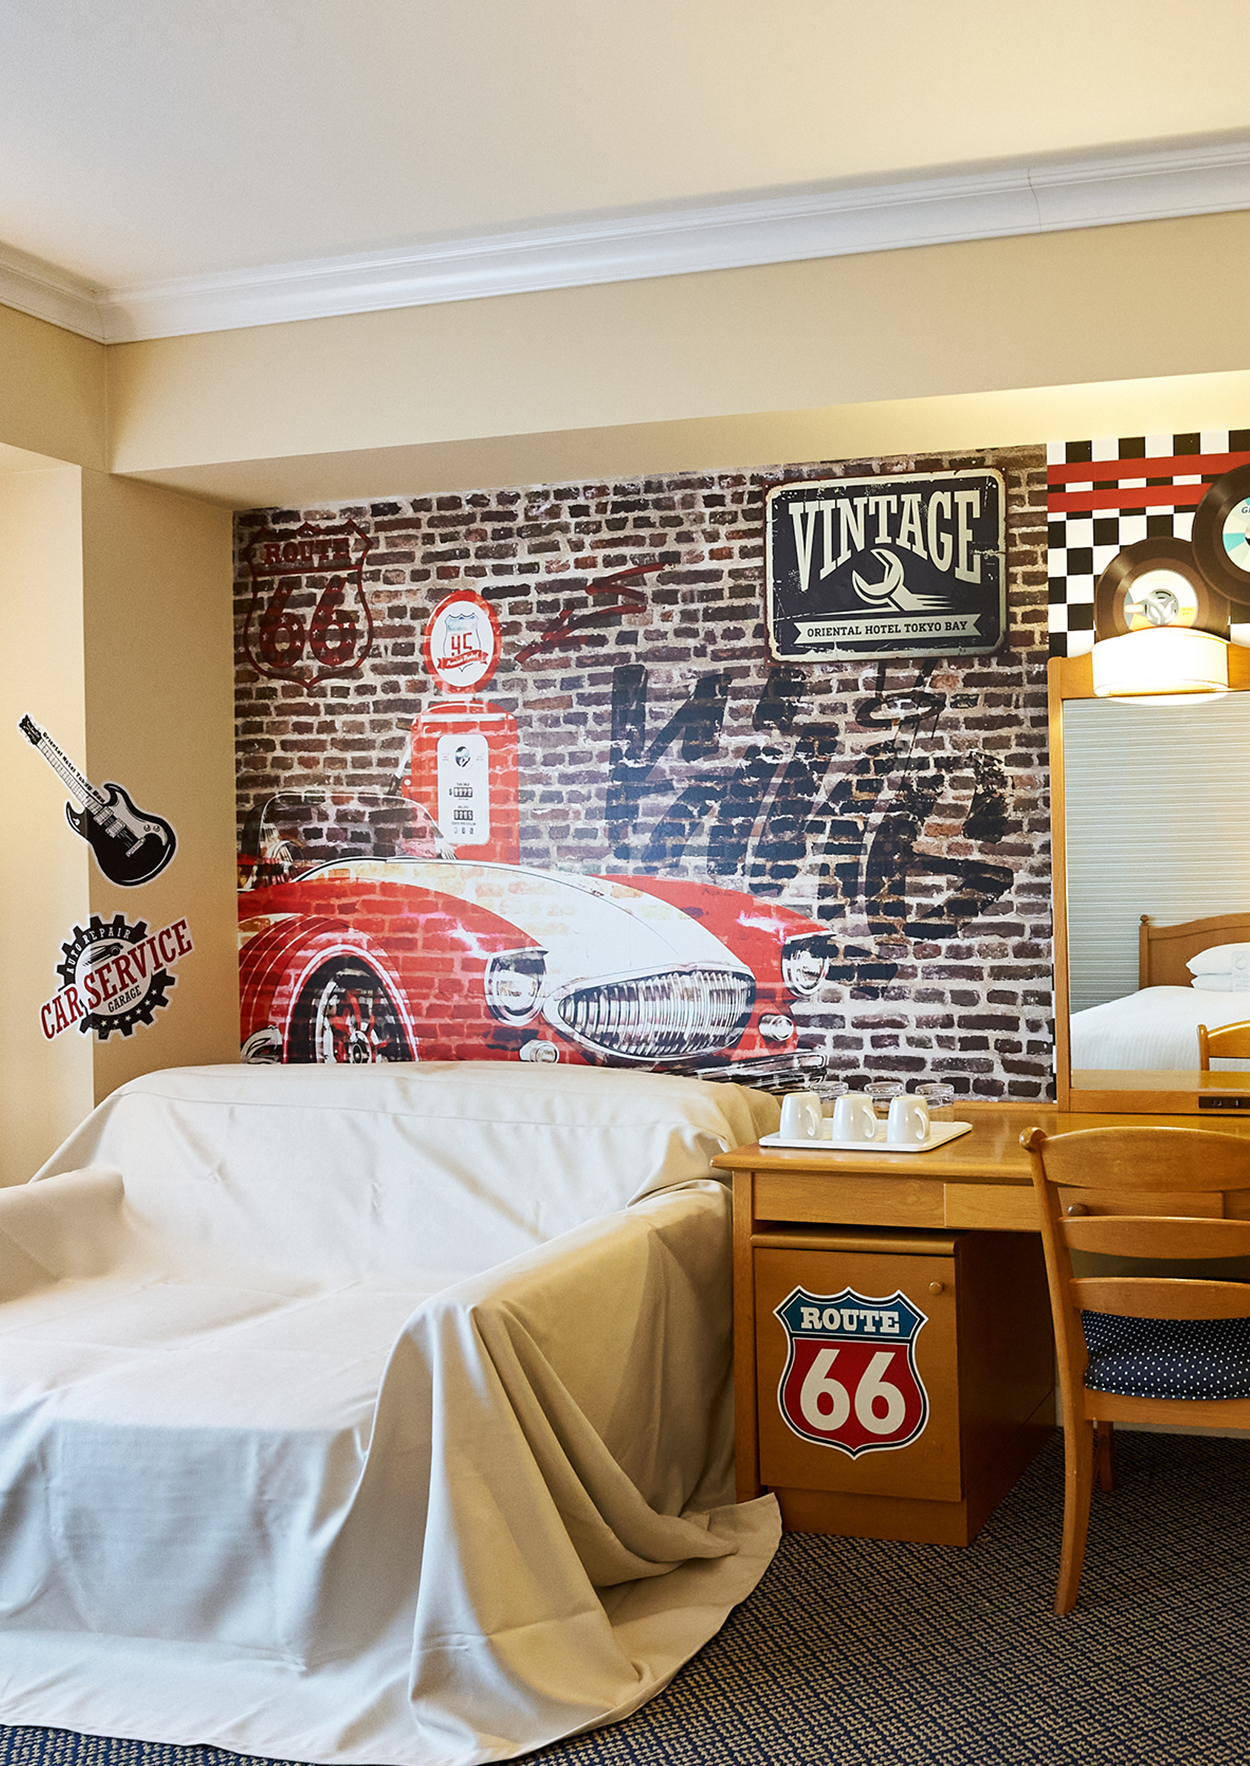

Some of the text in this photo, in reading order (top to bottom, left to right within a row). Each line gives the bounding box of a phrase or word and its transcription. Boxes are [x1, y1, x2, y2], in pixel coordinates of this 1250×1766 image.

[264, 537, 350, 565] ROUTE
[788, 489, 982, 593] VINTAGE
[260, 577, 357, 669] 66
[807, 620, 968, 638] ORIENTAL HOTEL TOKYO BAY
[66, 926, 132, 974] AUTO REPAIR
[40, 919, 193, 1039] CAR SERVICE
[107, 985, 142, 1013] GARAGE
[800, 1306, 900, 1334] ROUTE
[800, 1348, 906, 1435] 66
